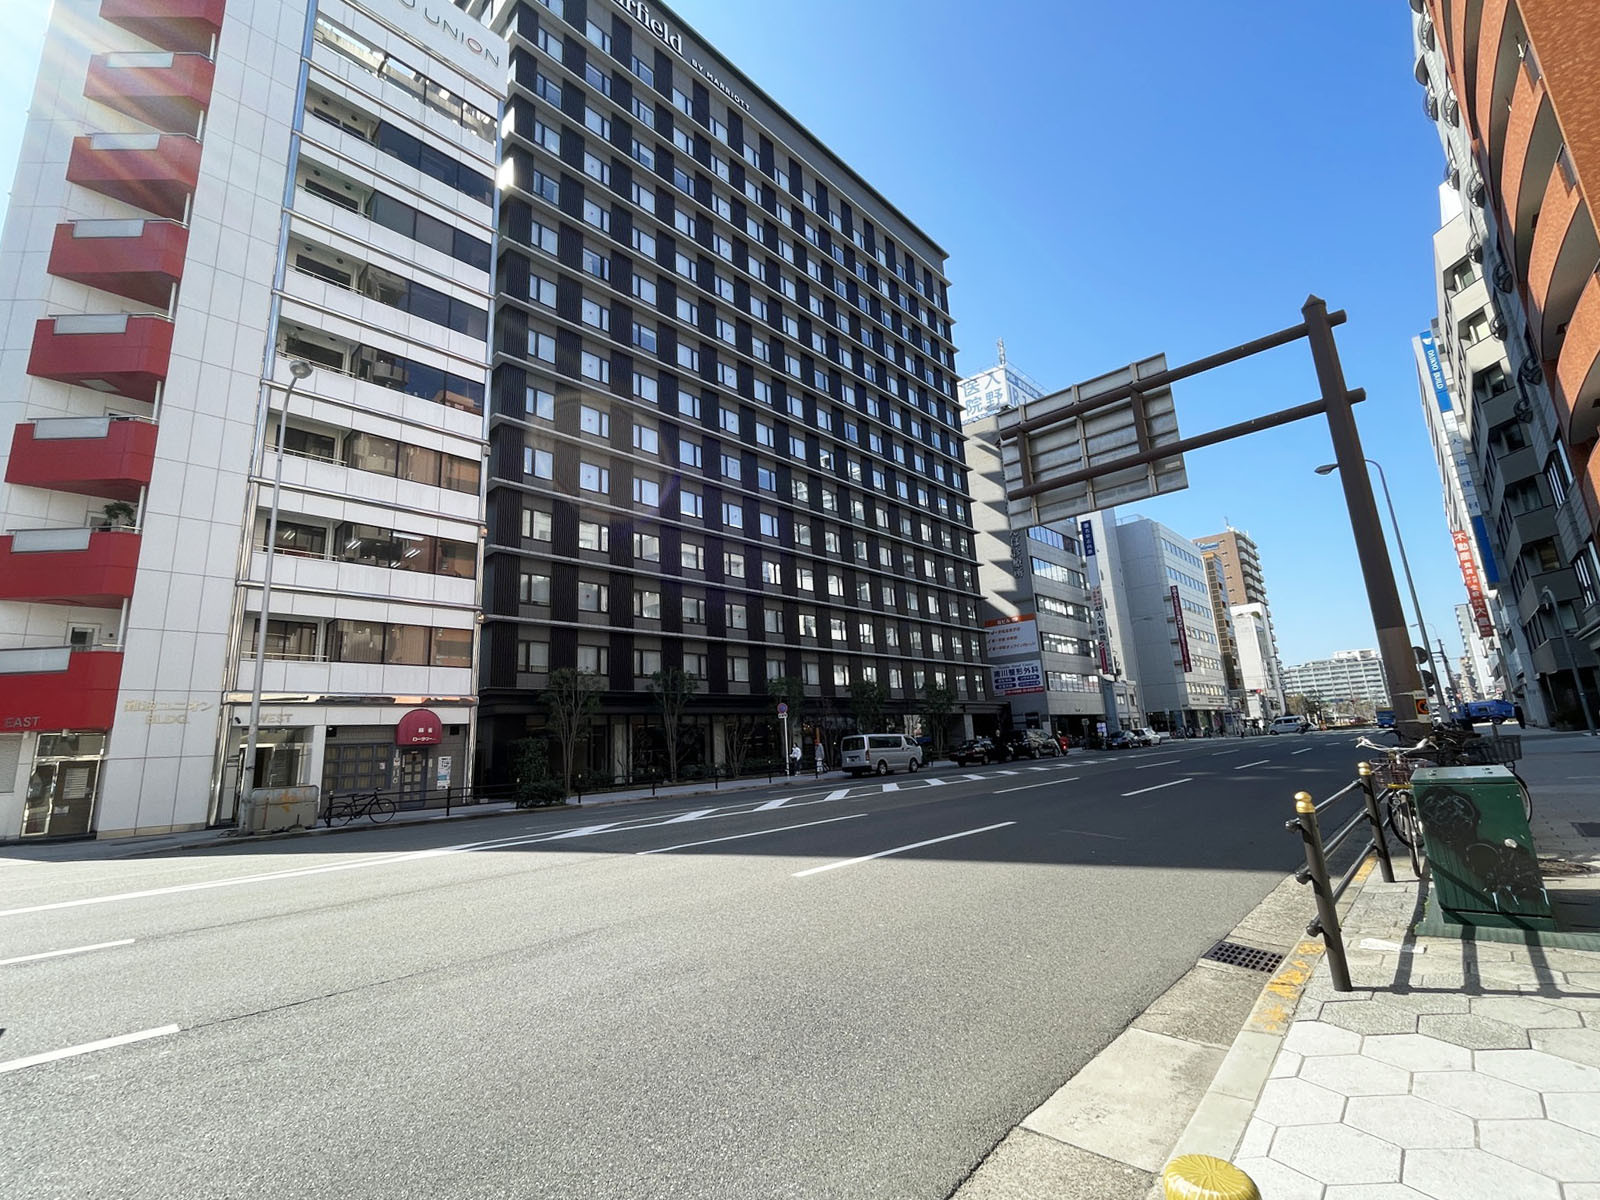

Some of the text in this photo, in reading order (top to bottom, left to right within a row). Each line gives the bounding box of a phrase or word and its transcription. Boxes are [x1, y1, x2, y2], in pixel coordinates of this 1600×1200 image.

[424, 7, 499, 68] UNION
[612, 0, 751, 111] rfield BY MARRIOTT
[5, 716, 40, 728] EAST
